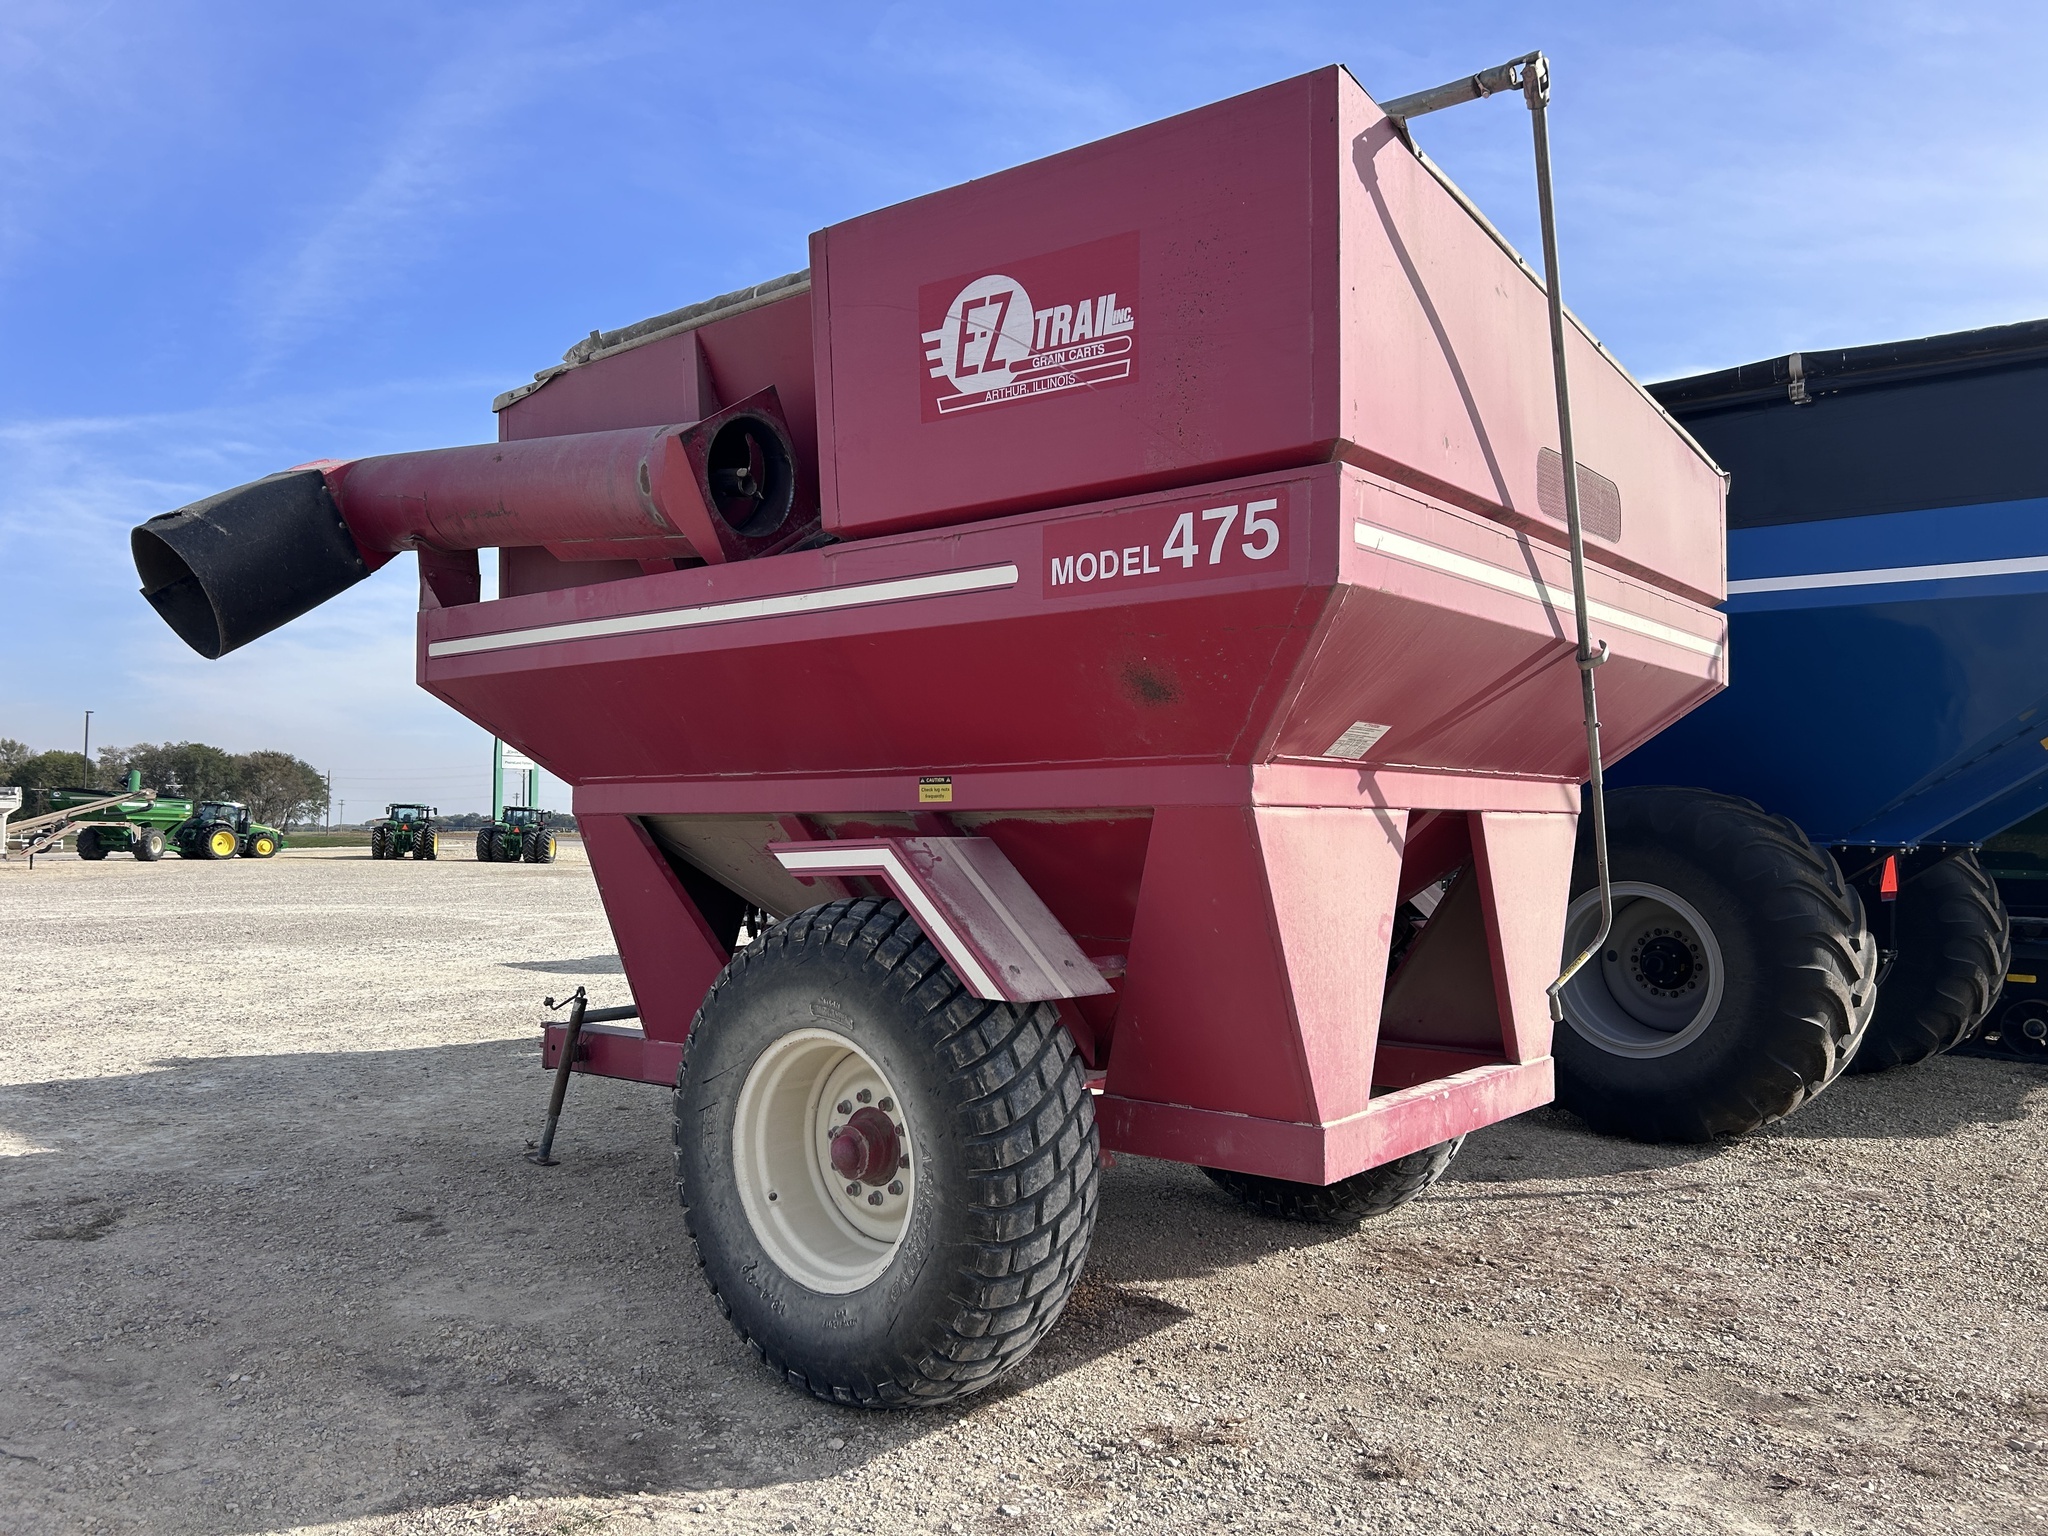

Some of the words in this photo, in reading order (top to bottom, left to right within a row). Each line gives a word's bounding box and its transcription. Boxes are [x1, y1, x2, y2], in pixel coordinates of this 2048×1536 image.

[1034, 292, 1134, 351] TRAIL
[1112, 306, 1134, 325] INC.
[1032, 350, 1065, 368] GRAIN
[1069, 343, 1105, 361] CARTS
[1033, 373, 1076, 392] ILLINOIS
[1051, 545, 1160, 586] MODEL
[1162, 498, 1280, 569] 475
